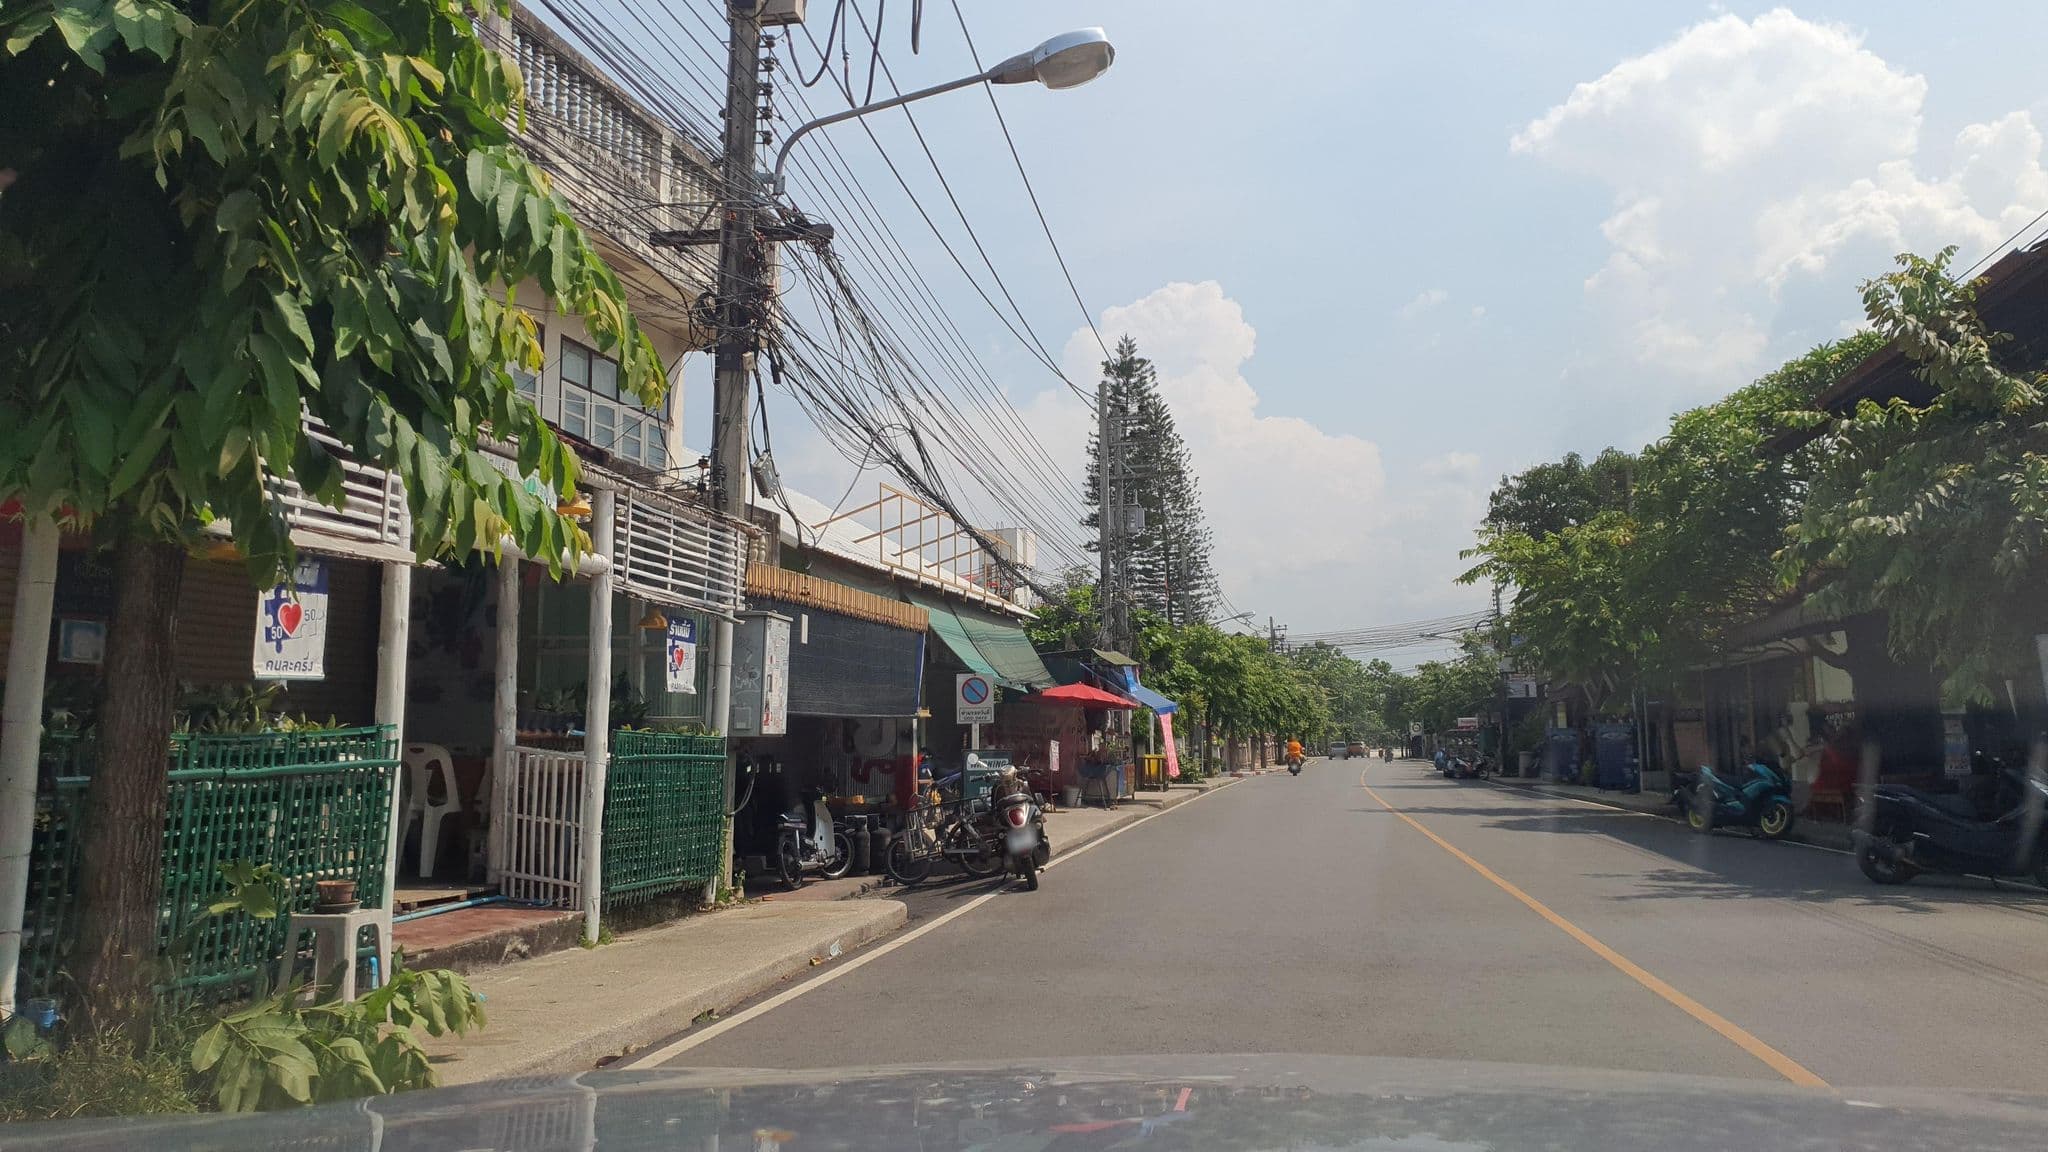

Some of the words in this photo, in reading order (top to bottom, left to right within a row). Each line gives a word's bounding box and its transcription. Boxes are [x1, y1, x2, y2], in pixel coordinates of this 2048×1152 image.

[304, 609, 316, 621] 50
[271, 627, 283, 639] 50
[266, 652, 314, 672] คนละครึ่ง
